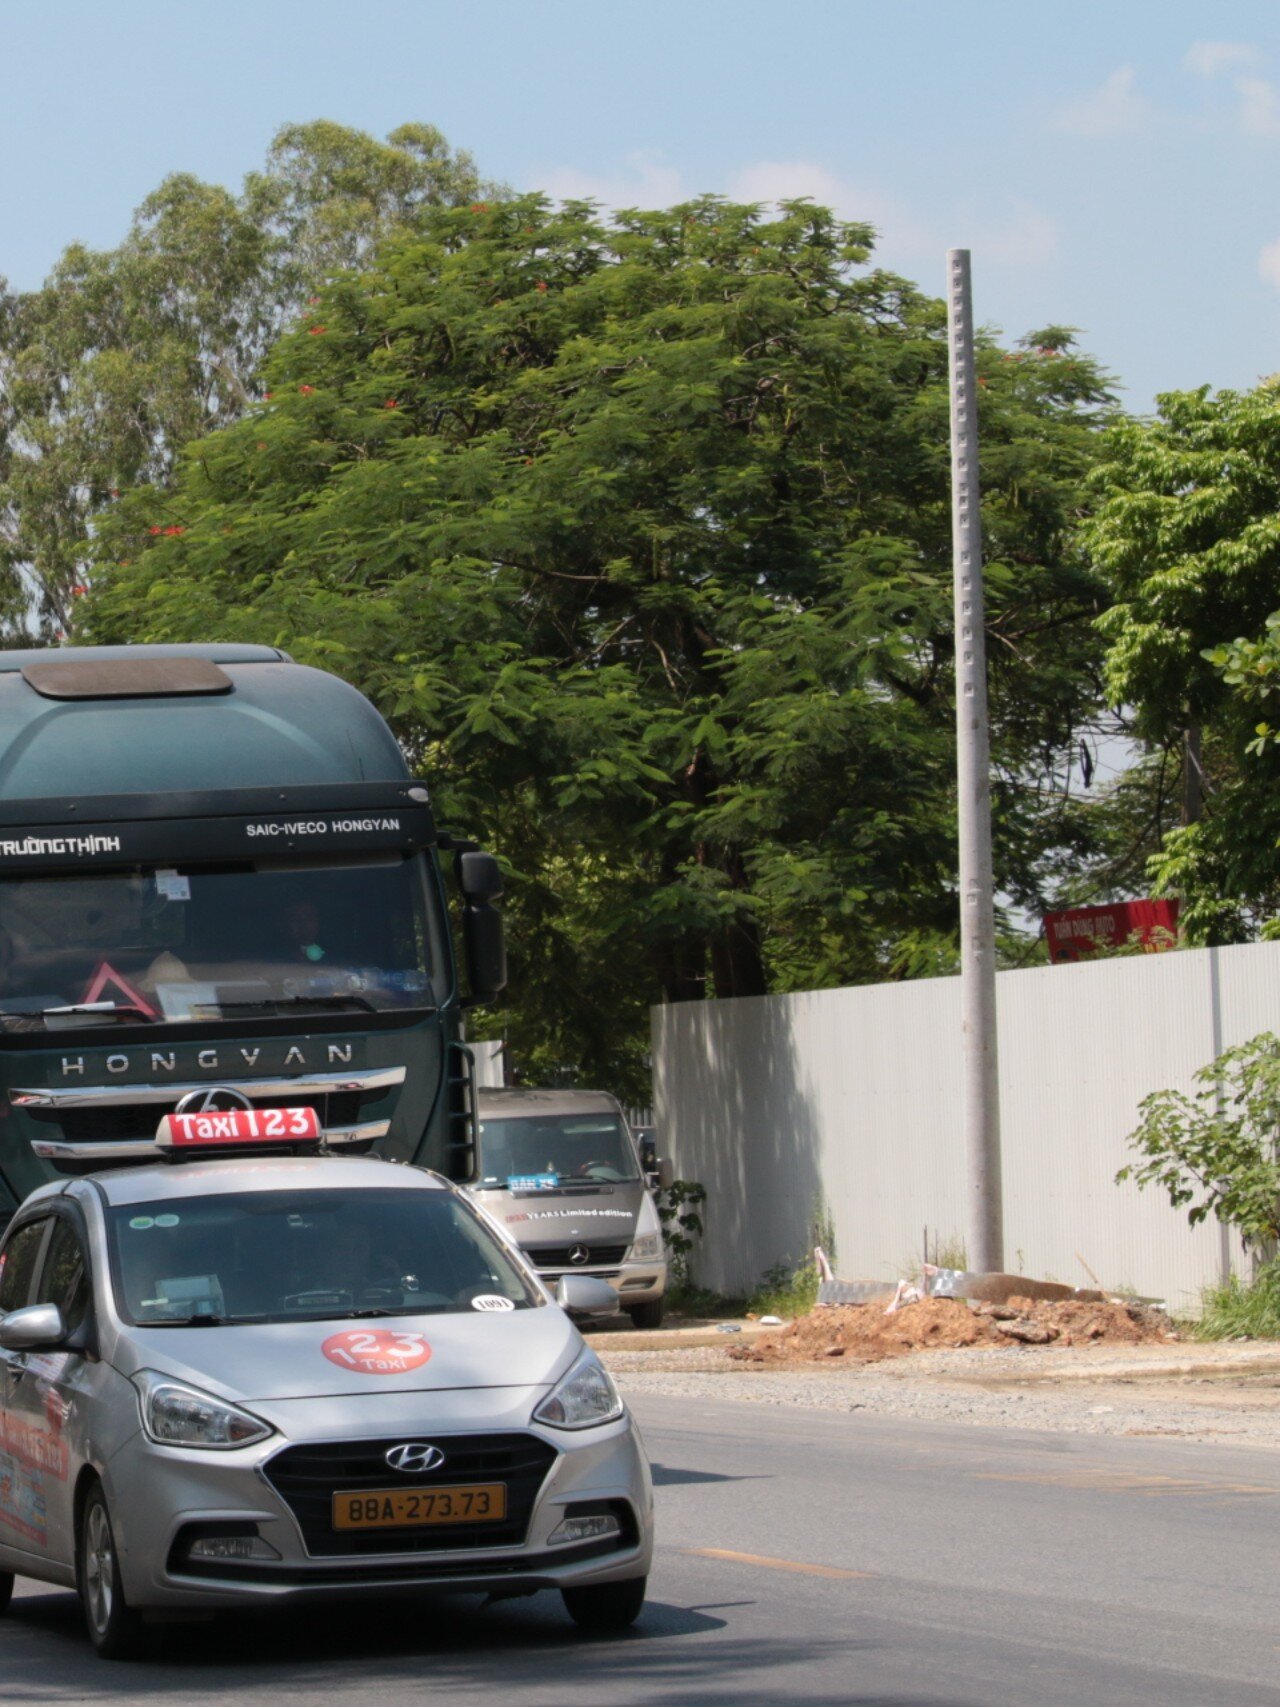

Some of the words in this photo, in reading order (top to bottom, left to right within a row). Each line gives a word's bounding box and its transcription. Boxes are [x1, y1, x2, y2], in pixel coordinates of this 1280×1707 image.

[246, 821, 328, 837] SAIC-IVECO
[331, 818, 401, 833] HONGYAN
[61, 1044, 352, 1076] HONGYAN
[175, 1112, 239, 1139] Taxi
[242, 1108, 310, 1137] 123
[559, 1208, 598, 1217] Limited
[598, 1208, 633, 1218] edition
[331, 1331, 425, 1365] 123
[360, 1357, 406, 1371] Taxi
[348, 1491, 491, 1522] 88A-273.73
